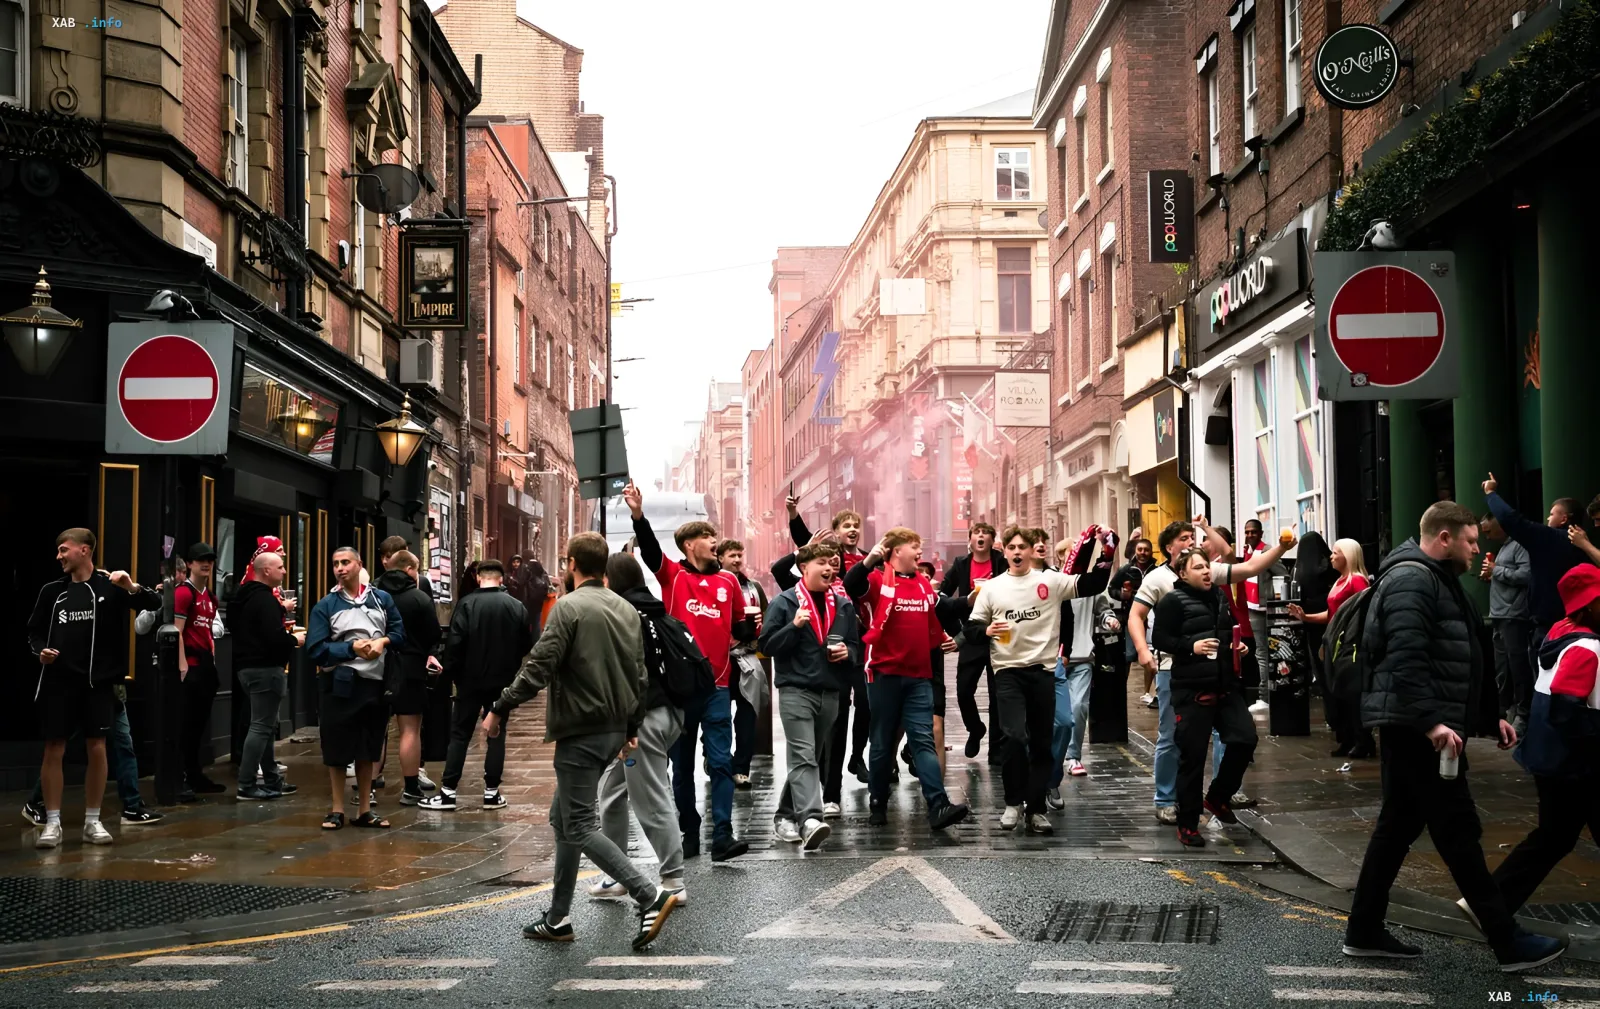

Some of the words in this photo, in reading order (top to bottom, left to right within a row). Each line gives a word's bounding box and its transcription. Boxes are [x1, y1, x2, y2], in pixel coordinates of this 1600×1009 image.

[1322, 45, 1391, 81] O'Neill's
[414, 302, 456, 318] EMPIRE
[1007, 386, 1037, 395] VILLA
